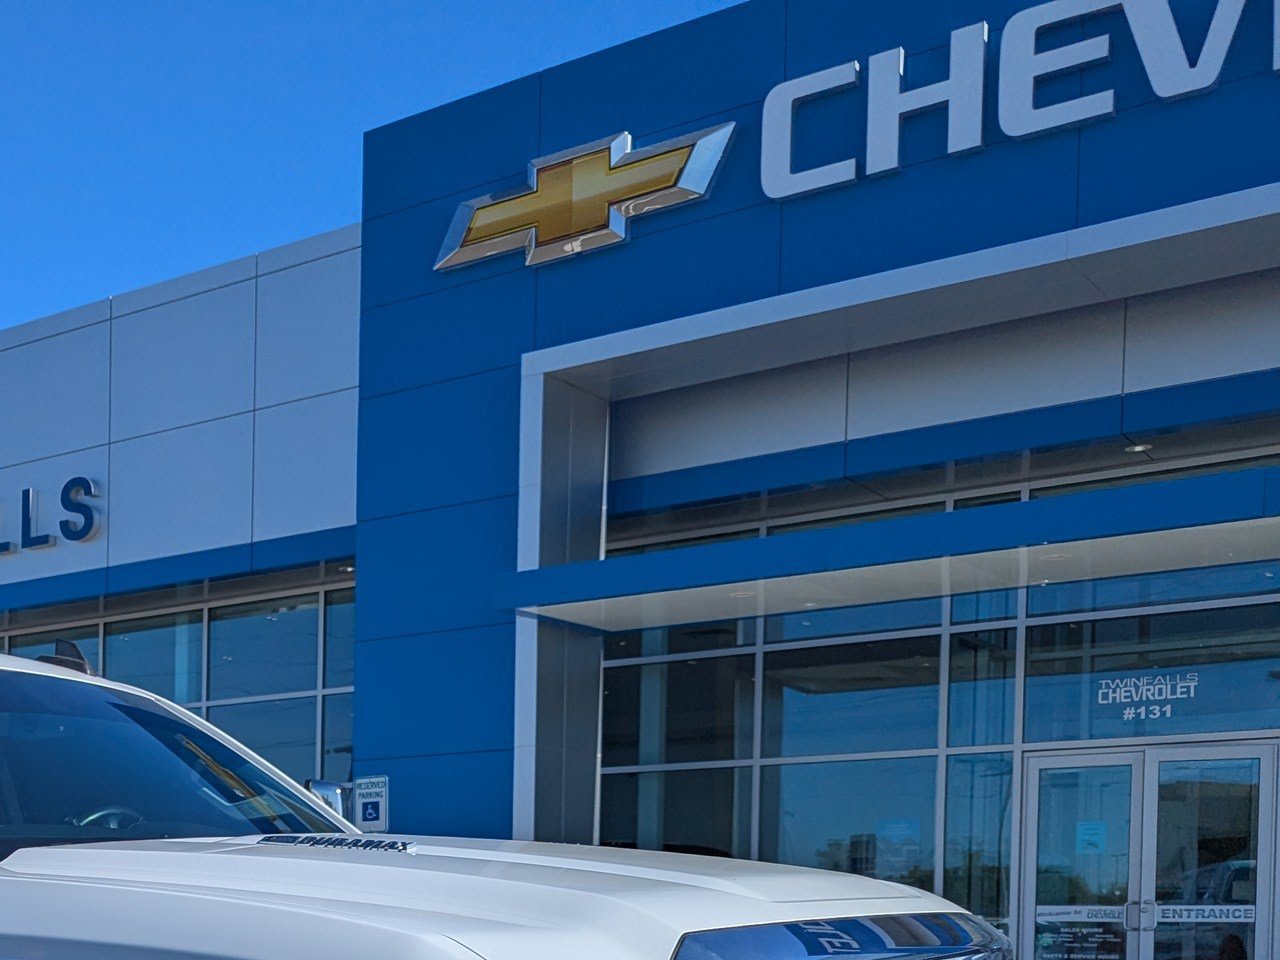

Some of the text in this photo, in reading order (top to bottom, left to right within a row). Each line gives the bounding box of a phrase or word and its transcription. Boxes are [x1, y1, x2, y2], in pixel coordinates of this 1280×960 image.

[760, 0, 1280, 201] CHEV
[1098, 682, 1199, 704] CHEVROLET
[1123, 704, 1172, 720] #131
[355, 781, 386, 790] RESERVED
[357, 791, 384, 799] PARKING
[296, 836, 413, 852] DURAMAX
[1161, 908, 1254, 919] ENTRANCE
